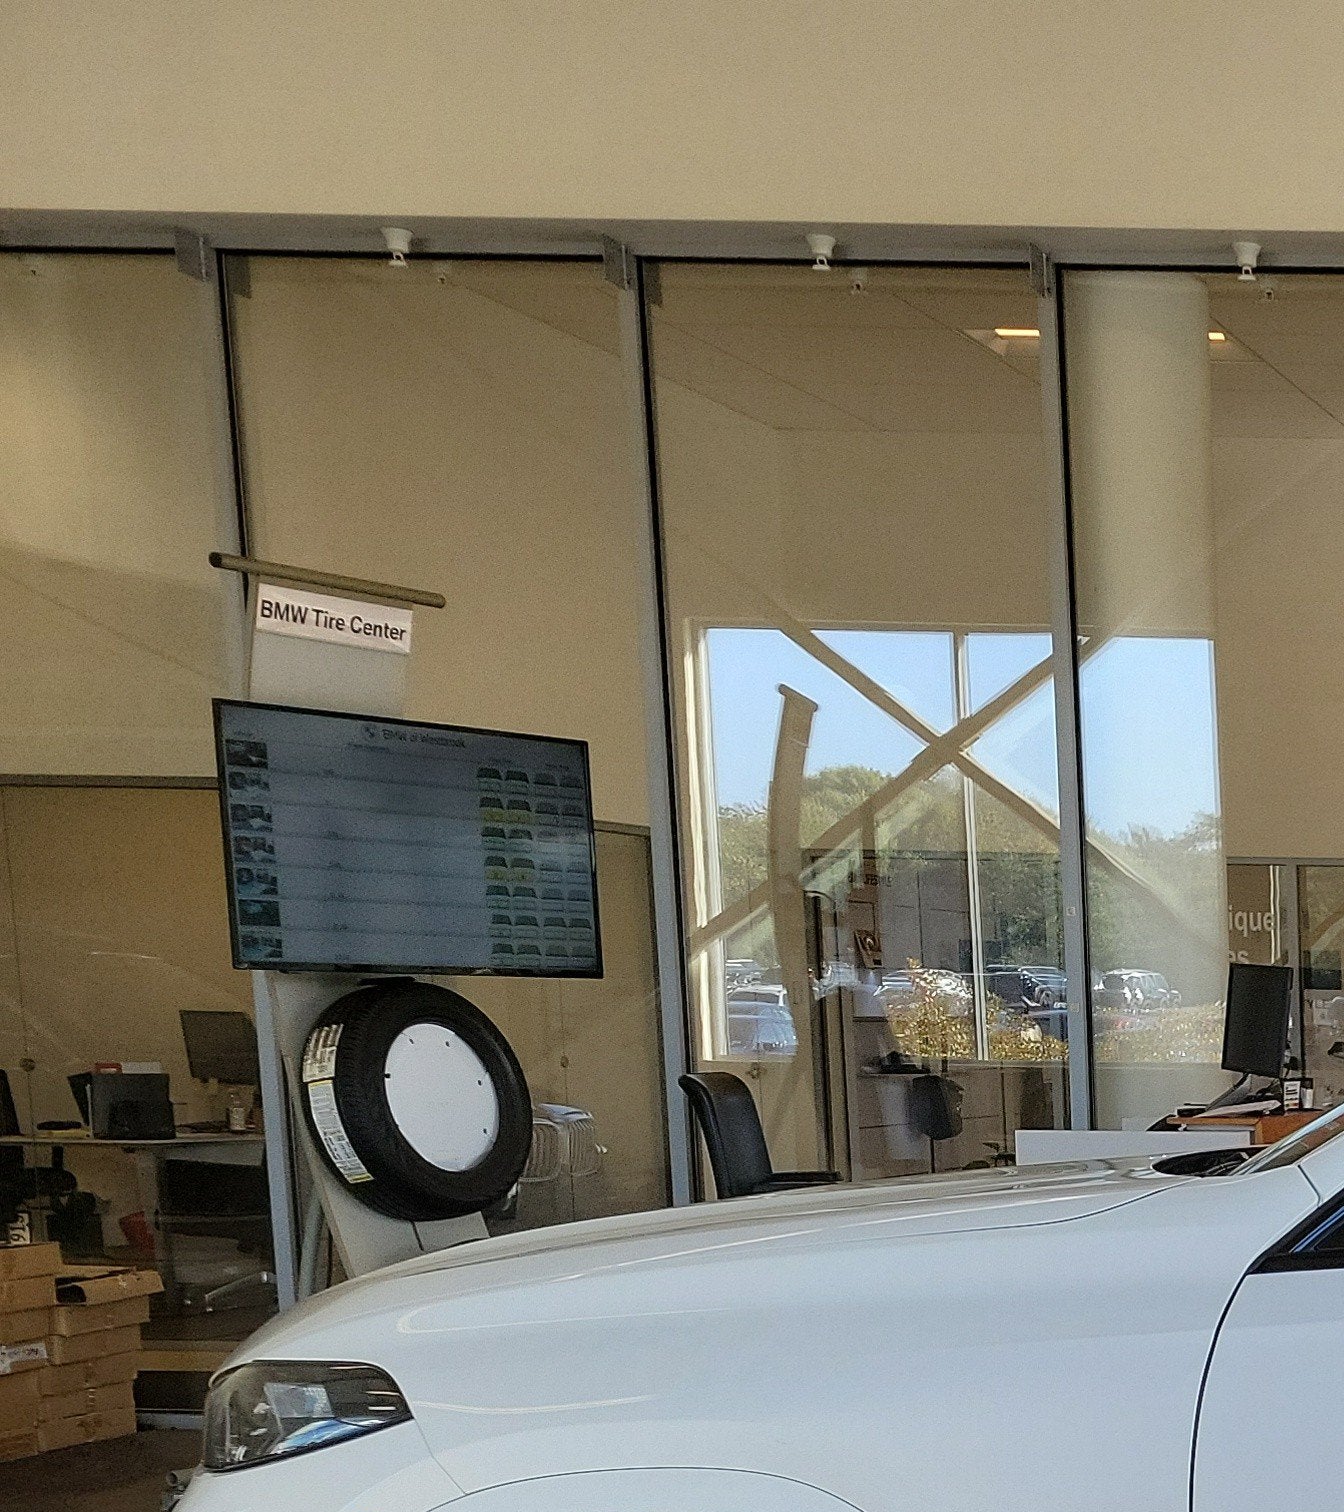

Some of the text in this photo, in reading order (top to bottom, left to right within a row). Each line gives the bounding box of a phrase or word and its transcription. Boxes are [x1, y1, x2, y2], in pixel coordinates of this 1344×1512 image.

[260, 599, 407, 641] BMW Tire Center
